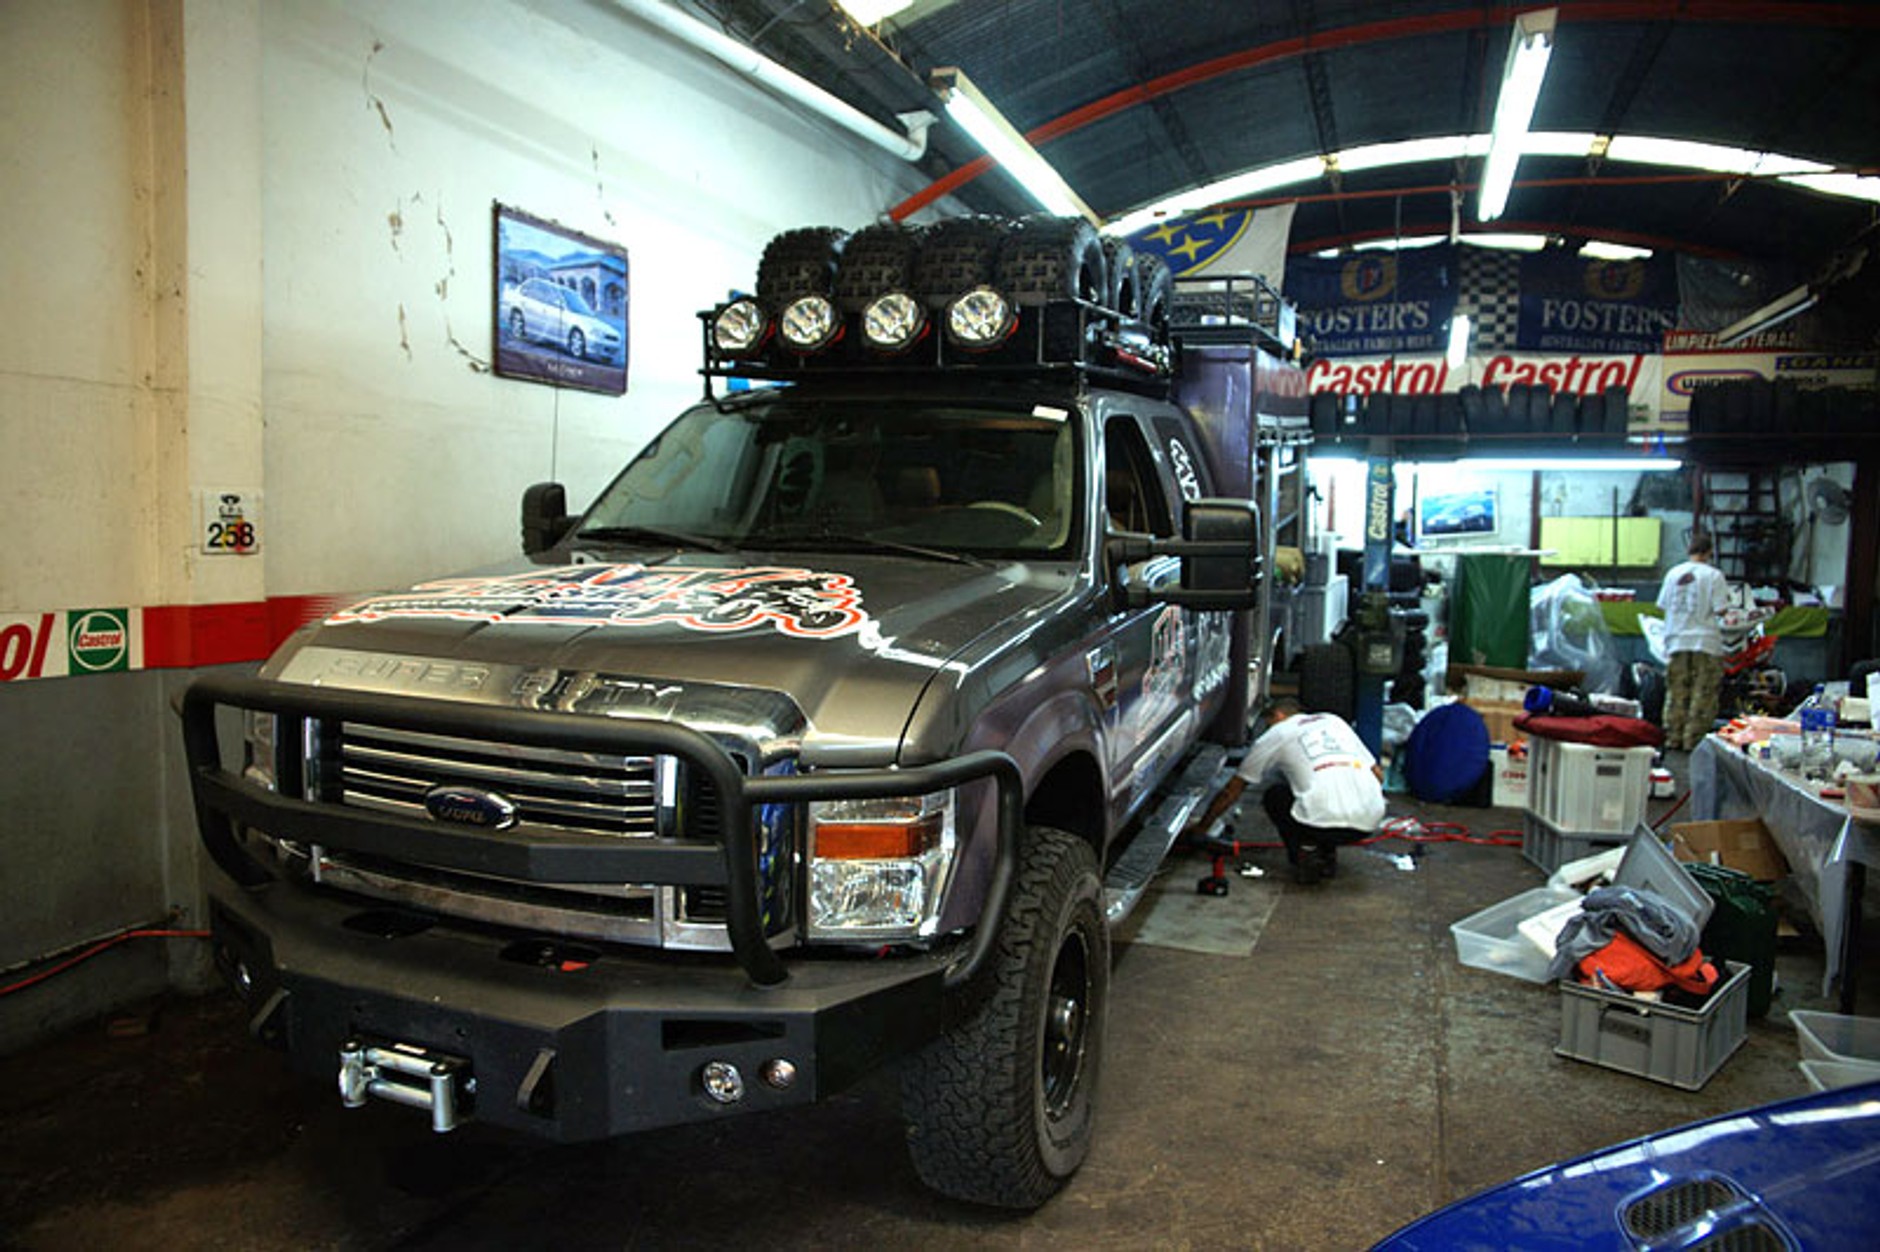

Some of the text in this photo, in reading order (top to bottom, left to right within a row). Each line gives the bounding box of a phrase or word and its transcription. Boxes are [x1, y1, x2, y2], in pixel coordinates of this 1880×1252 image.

[1299, 300, 1430, 336] FOSTER'S
[1541, 298, 1675, 335] FOSTER'S
[1666, 334, 1722, 350] LIMPIEZ
[1307, 357, 1449, 397] Castrol
[1482, 354, 1643, 397] Castrol
[207, 521, 255, 549] 258
[78, 632, 122, 648] Castrol
[332, 656, 683, 703] SUPER DUTY
